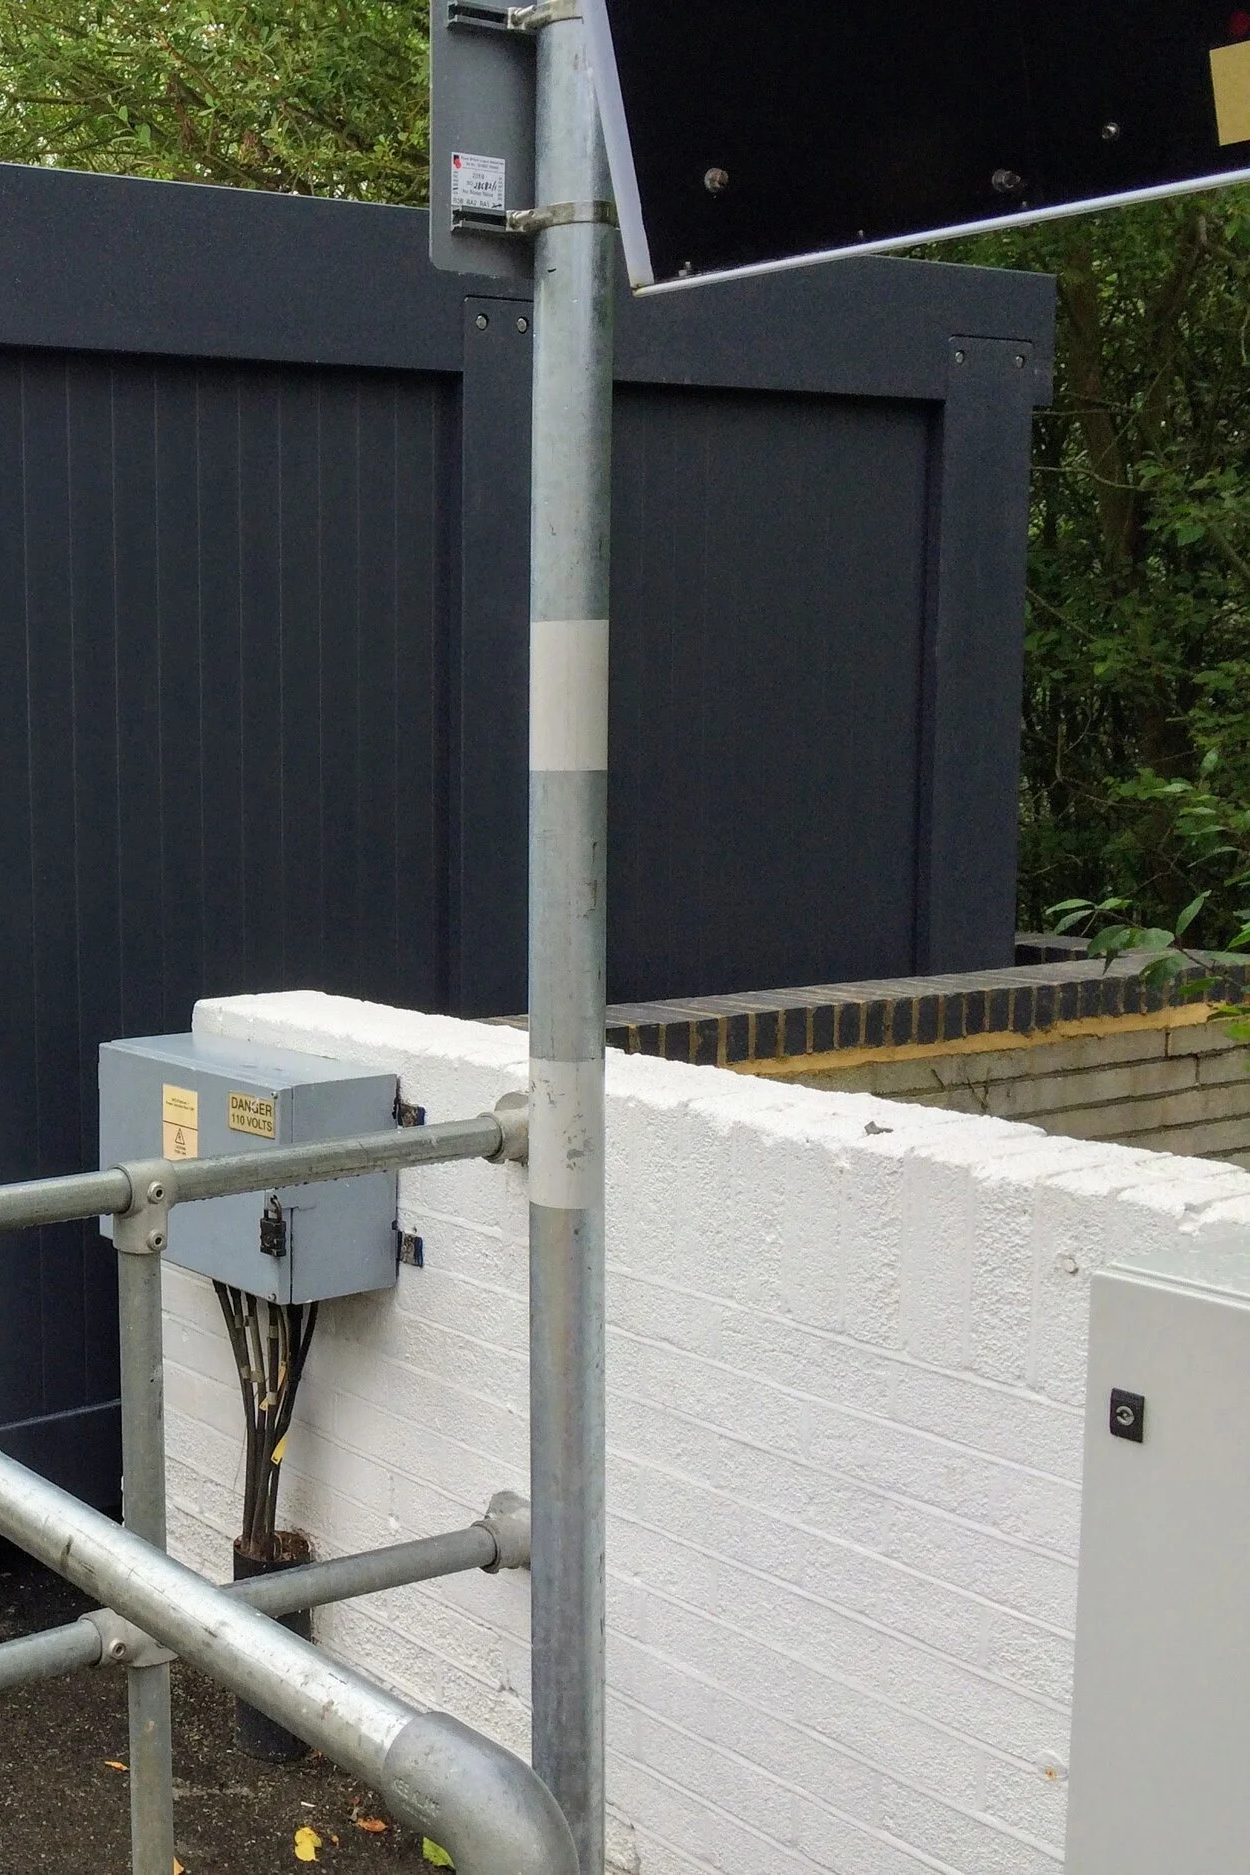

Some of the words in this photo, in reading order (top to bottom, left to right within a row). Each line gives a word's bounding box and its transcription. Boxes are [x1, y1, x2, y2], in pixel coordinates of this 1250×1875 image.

[231, 1096, 272, 1117] DANGER
[231, 1113, 245, 1126] 110
[246, 1116, 273, 1132] VOLTS
